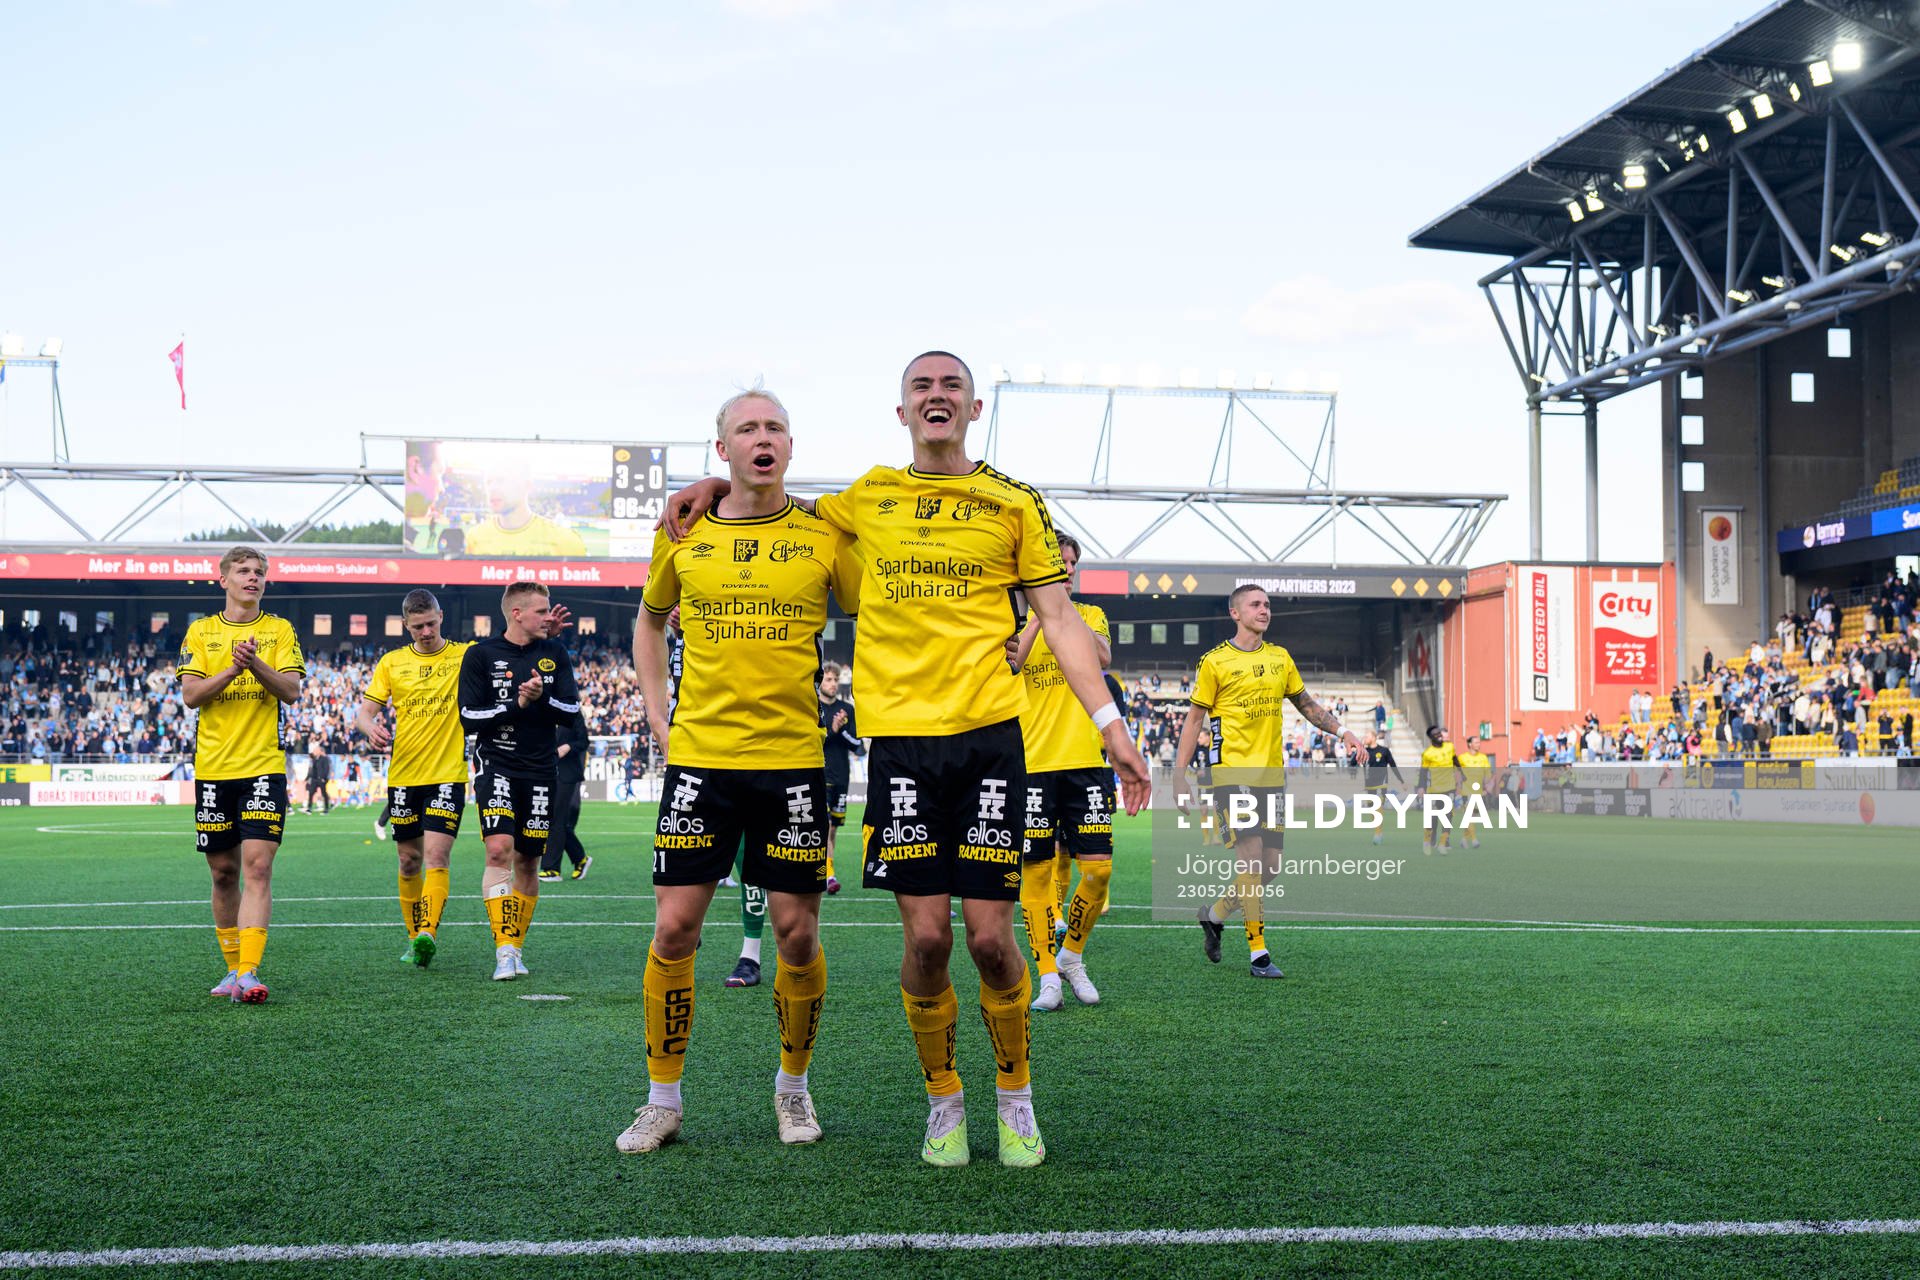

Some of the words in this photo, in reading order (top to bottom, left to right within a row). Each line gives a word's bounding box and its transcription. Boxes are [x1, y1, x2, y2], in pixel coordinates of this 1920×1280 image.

[616, 465, 629, 489] 3
[649, 465, 662, 489] 0
[88, 559, 121, 573] Mer
[125, 559, 144, 573] än
[148, 562, 170, 573] en
[173, 559, 213, 574] bank
[278, 563, 334, 574] Sparbanken
[336, 563, 378, 576] Sjuhärad
[482, 565, 512, 580] Mer
[517, 566, 535, 580] än
[539, 570, 558, 581] en
[562, 567, 600, 581] bank
[876, 557, 983, 579] Sparbanken
[885, 580, 968, 603] Sjuhärad
[1329, 581, 1356, 594] 2023
[1535, 577, 1545, 599] BIL
[692, 598, 803, 619] Sparbanken
[1599, 592, 1652, 617] City
[705, 622, 789, 643] Sjuhärad
[1535, 601, 1546, 670] BOGSTEDT
[1605, 651, 1646, 668] 7-23
[1024, 661, 1060, 676] Sparb
[544, 676, 554, 684] 20
[1033, 674, 1065, 690] Sjuhä
[247, 797, 276, 811] ellos
[430, 799, 456, 812] ellos
[487, 796, 513, 809] ellos
[197, 808, 226, 822] ellos
[242, 811, 281, 822] RAMIRENT
[390, 805, 412, 818] ellos
[426, 807, 459, 821] RAMIRENT
[483, 808, 515, 821] RAMIREN
[1084, 809, 1110, 824] ellos
[485, 816, 500, 829] 17
[527, 816, 550, 830] ellos
[660, 811, 704, 834] ellos
[1025, 813, 1049, 828] llos
[777, 826, 821, 847] ellos
[883, 820, 928, 844] ellos
[967, 821, 1012, 847] ellos
[1024, 828, 1053, 838] MIRENT
[766, 844, 827, 862] RAMIRENT
[958, 844, 1020, 865] RAMIRENT
